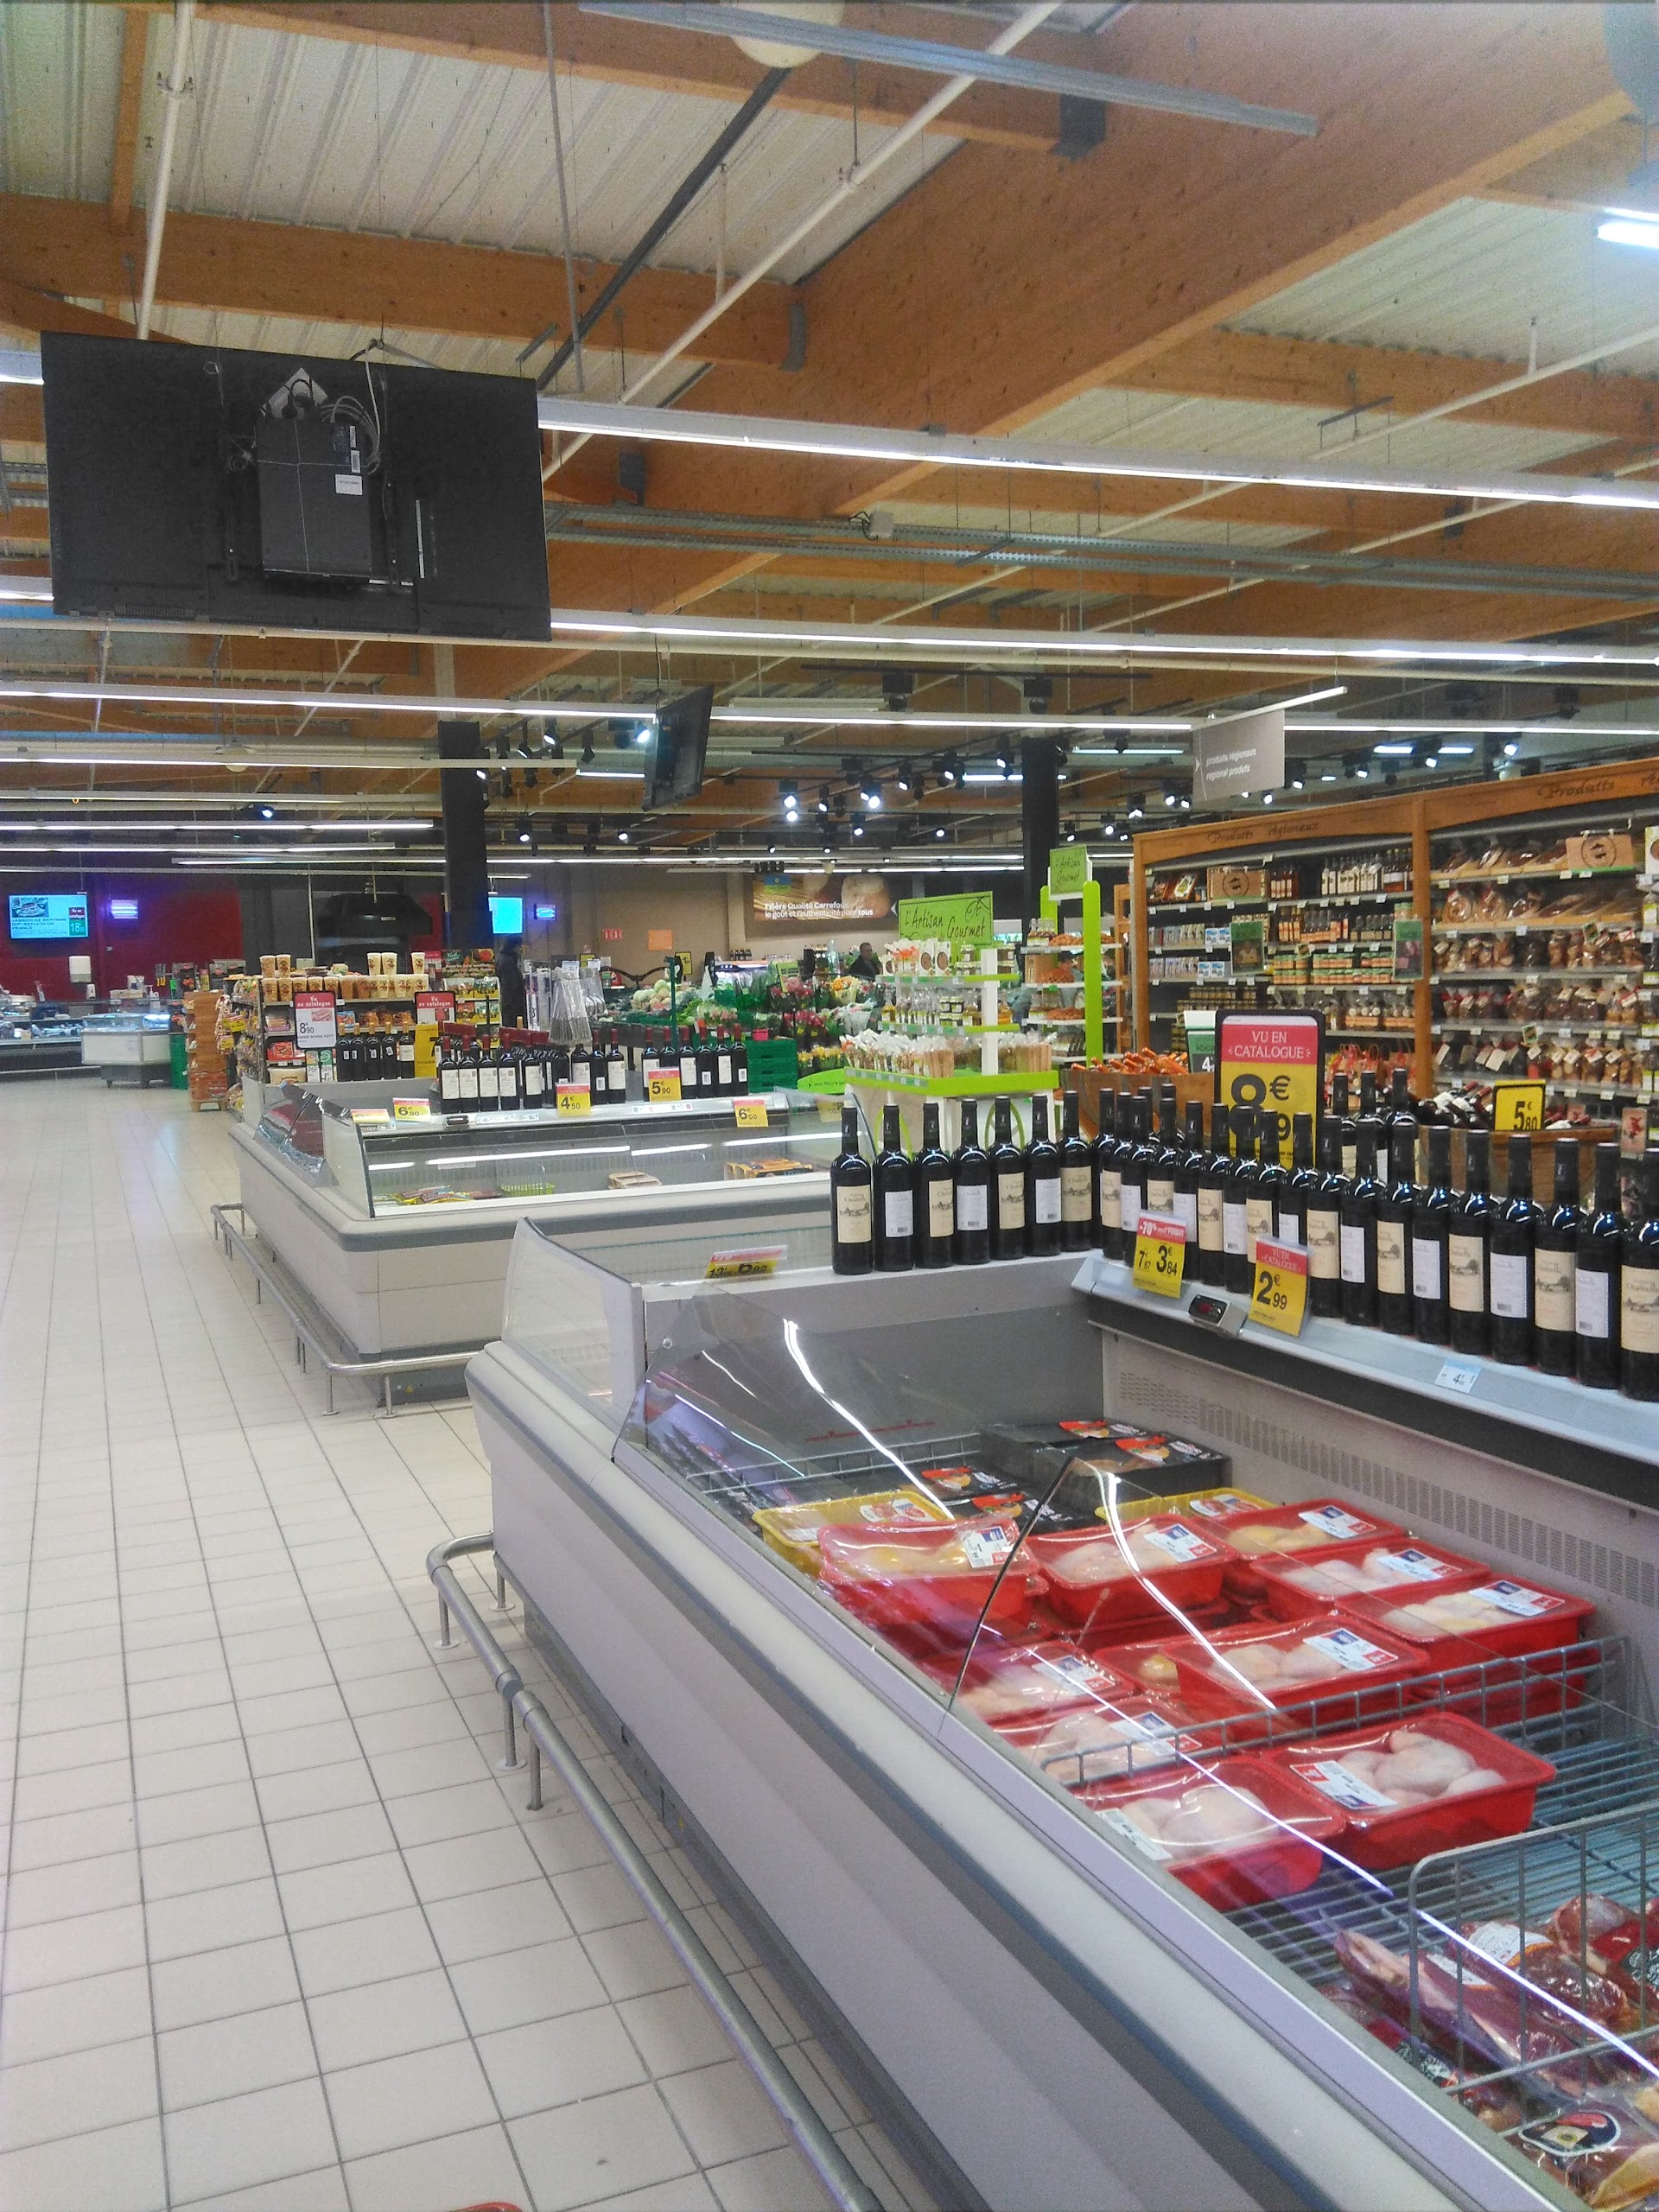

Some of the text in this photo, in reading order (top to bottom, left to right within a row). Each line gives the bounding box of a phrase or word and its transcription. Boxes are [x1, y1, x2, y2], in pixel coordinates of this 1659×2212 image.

[772, 911, 788, 919] goût
[946, 916, 986, 939] Gourmet
[1252, 1031, 1287, 1044] VU EN
[1234, 1045, 1304, 1059] CATALOGUE
